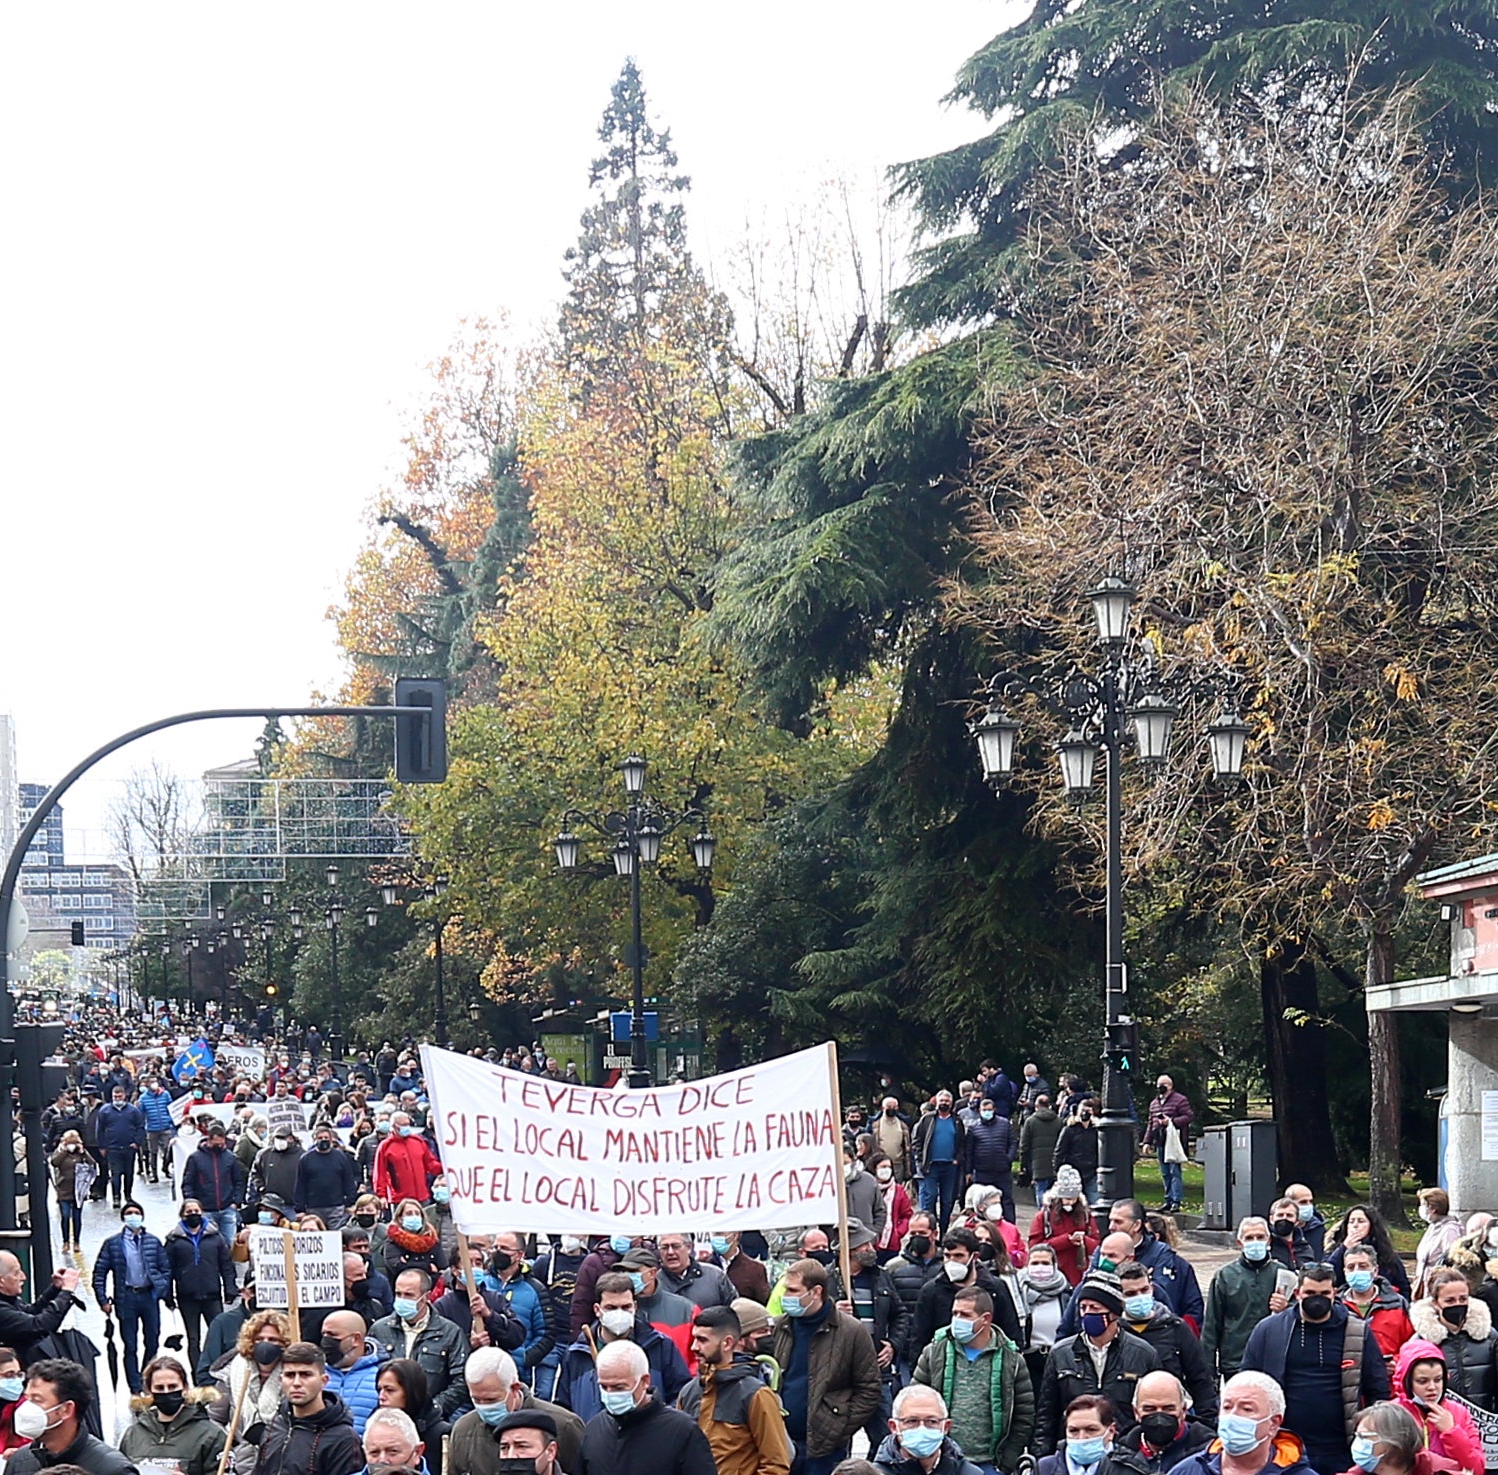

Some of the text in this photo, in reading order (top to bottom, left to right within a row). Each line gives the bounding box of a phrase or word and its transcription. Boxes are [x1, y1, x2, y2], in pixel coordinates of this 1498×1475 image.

[227, 1056, 259, 1068] EROS
[490, 1071, 756, 1119] TEVERGA DICE
[445, 1108, 835, 1164] SI EL LOCAL MANTIENE LA FAUNA
[447, 1164, 836, 1216] QUE EL LOCAL DISFRUTE LA CAZA
[291, 1236, 324, 1254] HORIZOS
[303, 1262, 340, 1282] SICARIOS
[313, 1286, 341, 1303] CAMPO
